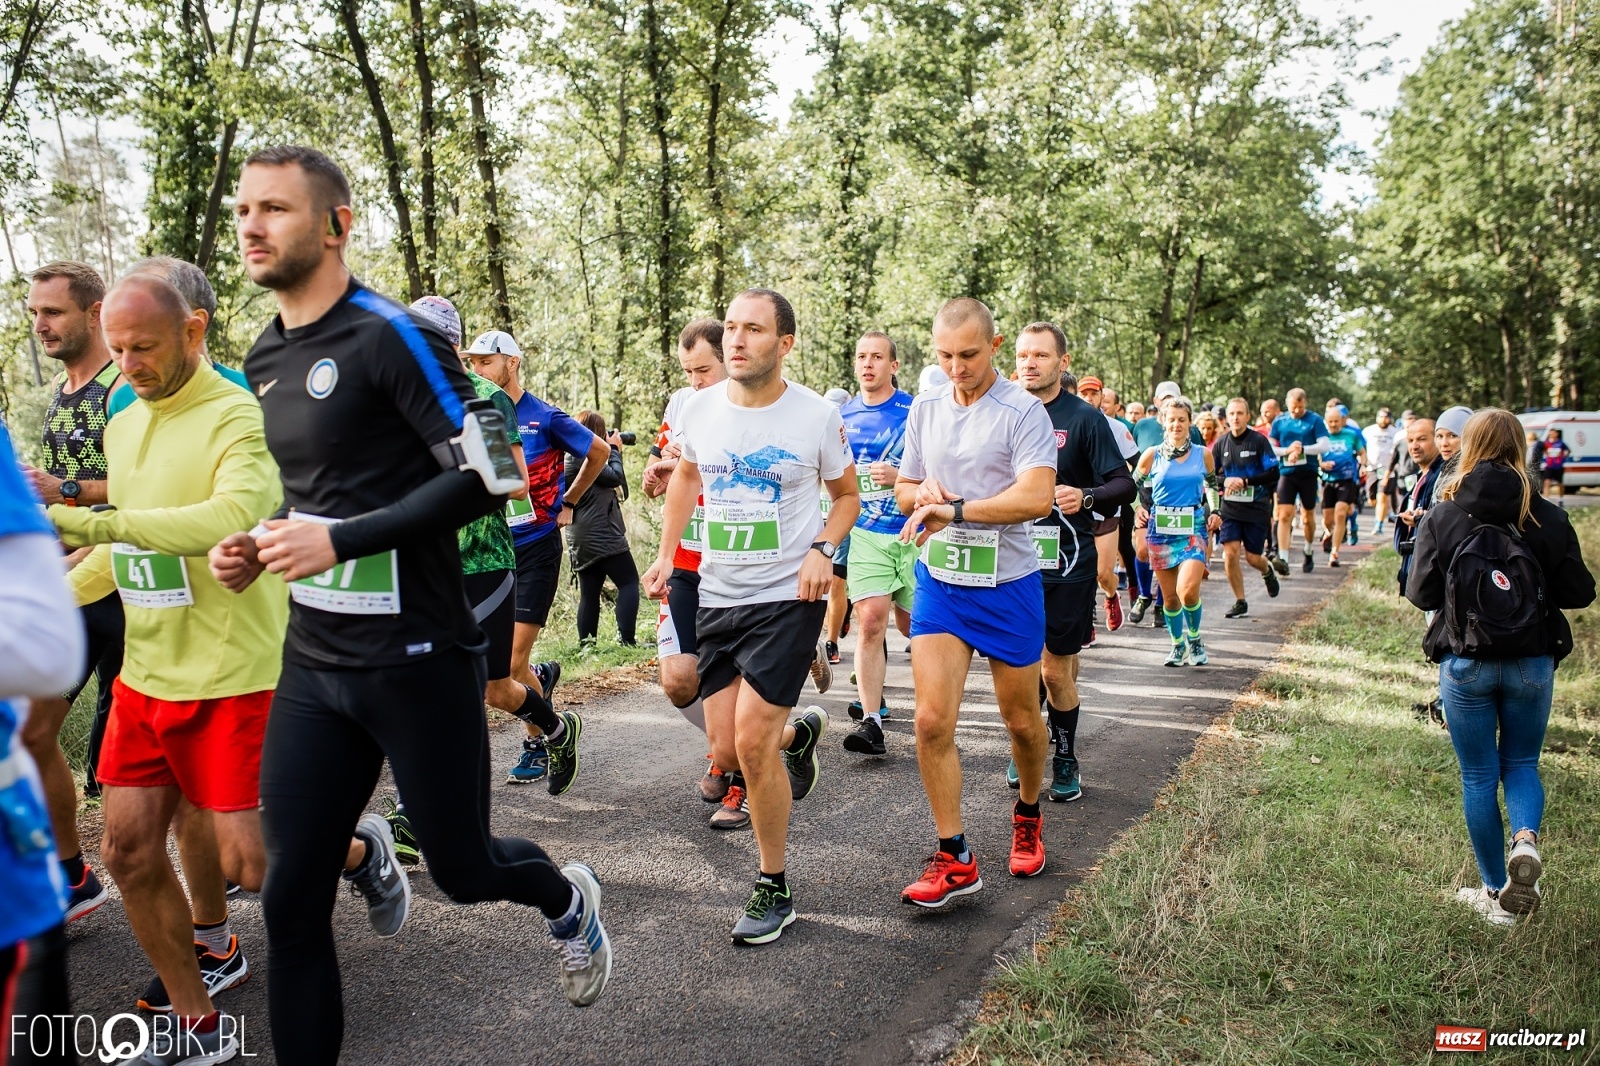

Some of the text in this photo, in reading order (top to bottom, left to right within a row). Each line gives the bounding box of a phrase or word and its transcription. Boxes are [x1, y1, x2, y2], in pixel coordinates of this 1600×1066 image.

[745, 467, 782, 482] MARATON
[1166, 515, 1182, 528] 21
[723, 525, 755, 550] 77
[945, 545, 971, 571] 31
[128, 558, 157, 589] 41
